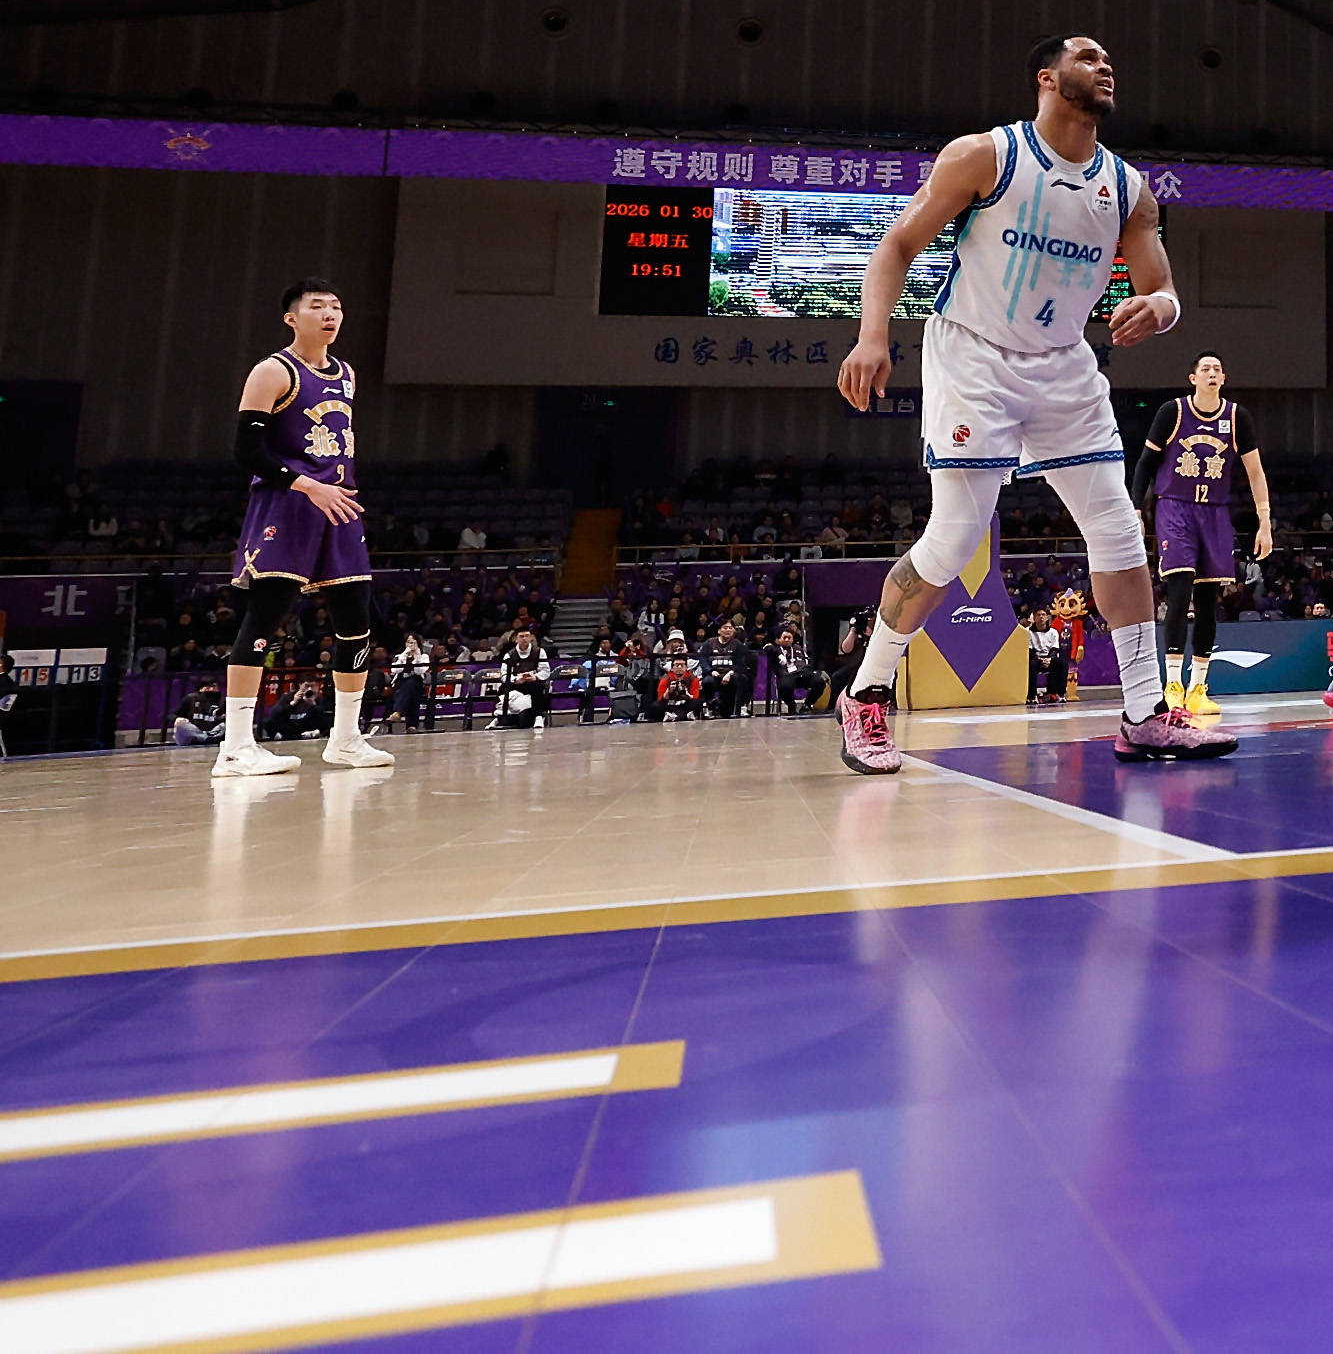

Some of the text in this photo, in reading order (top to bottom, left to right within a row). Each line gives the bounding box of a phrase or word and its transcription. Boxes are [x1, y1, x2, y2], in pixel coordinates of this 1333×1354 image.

[612, 148, 754, 182] 遵守规则
[768, 154, 903, 188] 尊重对手
[606, 203, 713, 220] 2026 01 30
[627, 232, 689, 249] 星期五
[1002, 229, 1102, 263] QINGDAO
[630, 263, 683, 278] 19:51
[1034, 299, 1055, 326] 4
[1174, 451, 1226, 480] 北京
[1194, 484, 1209, 503] 12
